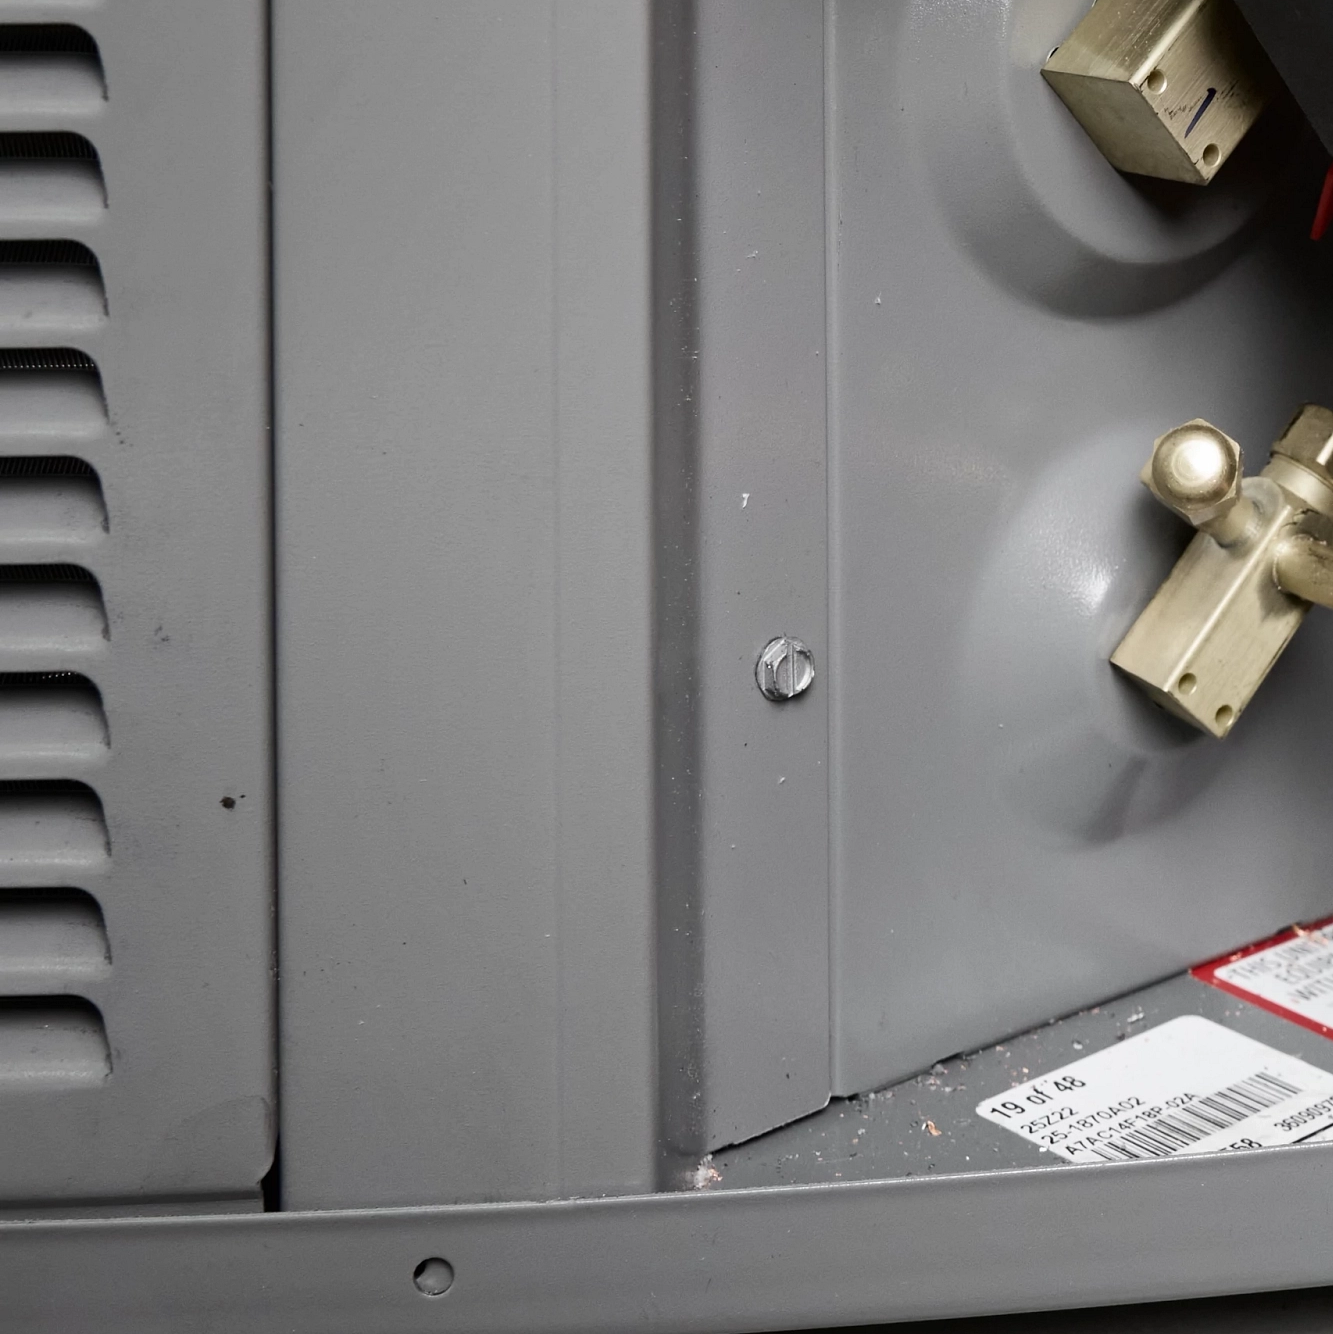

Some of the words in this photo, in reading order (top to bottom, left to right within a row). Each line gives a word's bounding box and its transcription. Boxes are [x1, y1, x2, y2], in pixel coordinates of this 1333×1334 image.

[990, 1101, 1026, 1118] 19
[1026, 1087, 1054, 1106] of
[1053, 1075, 1086, 1093] 48
[1020, 1106, 1079, 1134] 25Z22
[1041, 1096, 1146, 1145] 25-1870A02
